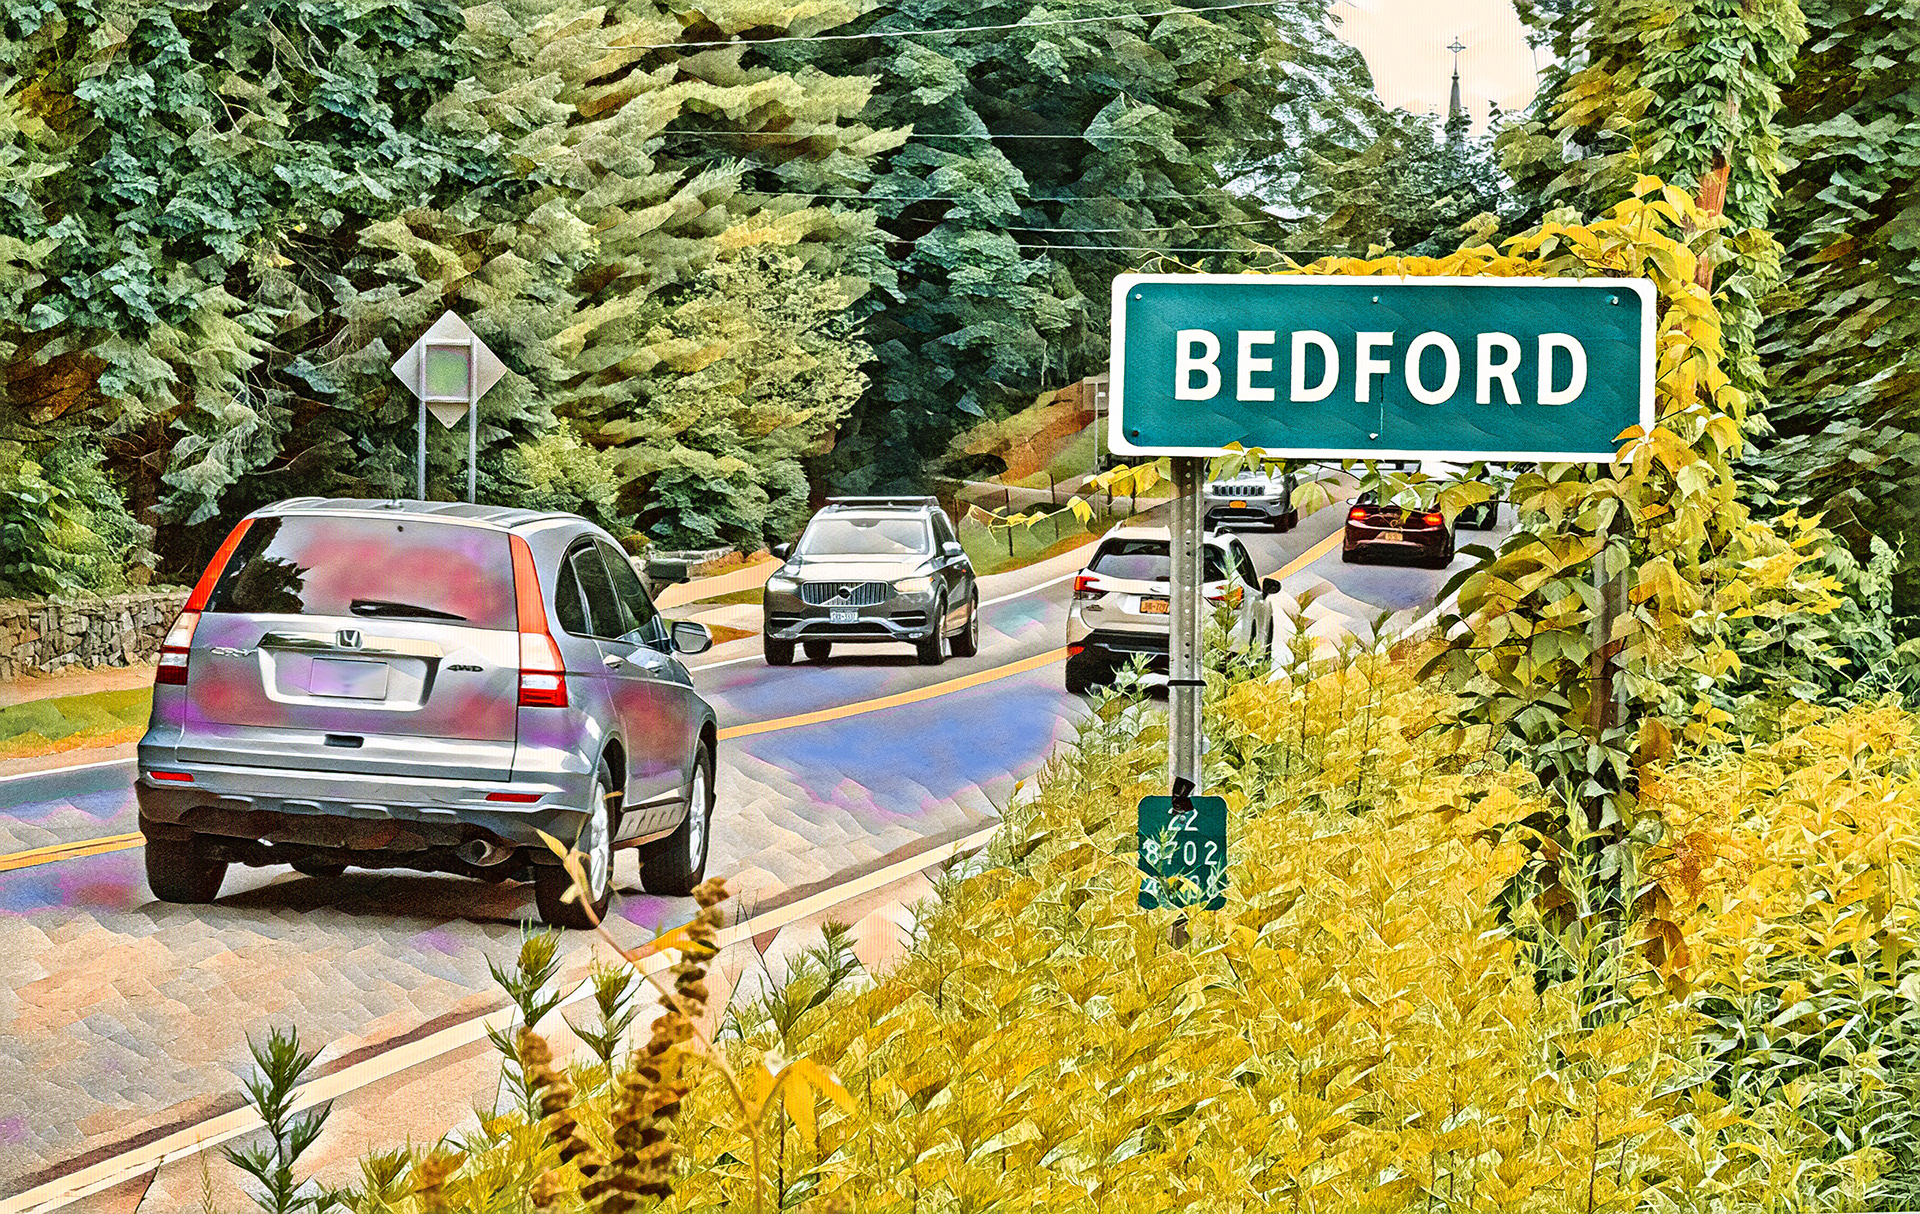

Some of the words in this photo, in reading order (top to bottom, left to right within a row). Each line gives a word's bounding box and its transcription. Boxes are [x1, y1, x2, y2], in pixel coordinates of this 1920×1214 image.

[1174, 328, 1588, 406] BEDFORD
[1167, 808, 1199, 832] 22
[1144, 839, 1218, 867] 8702
